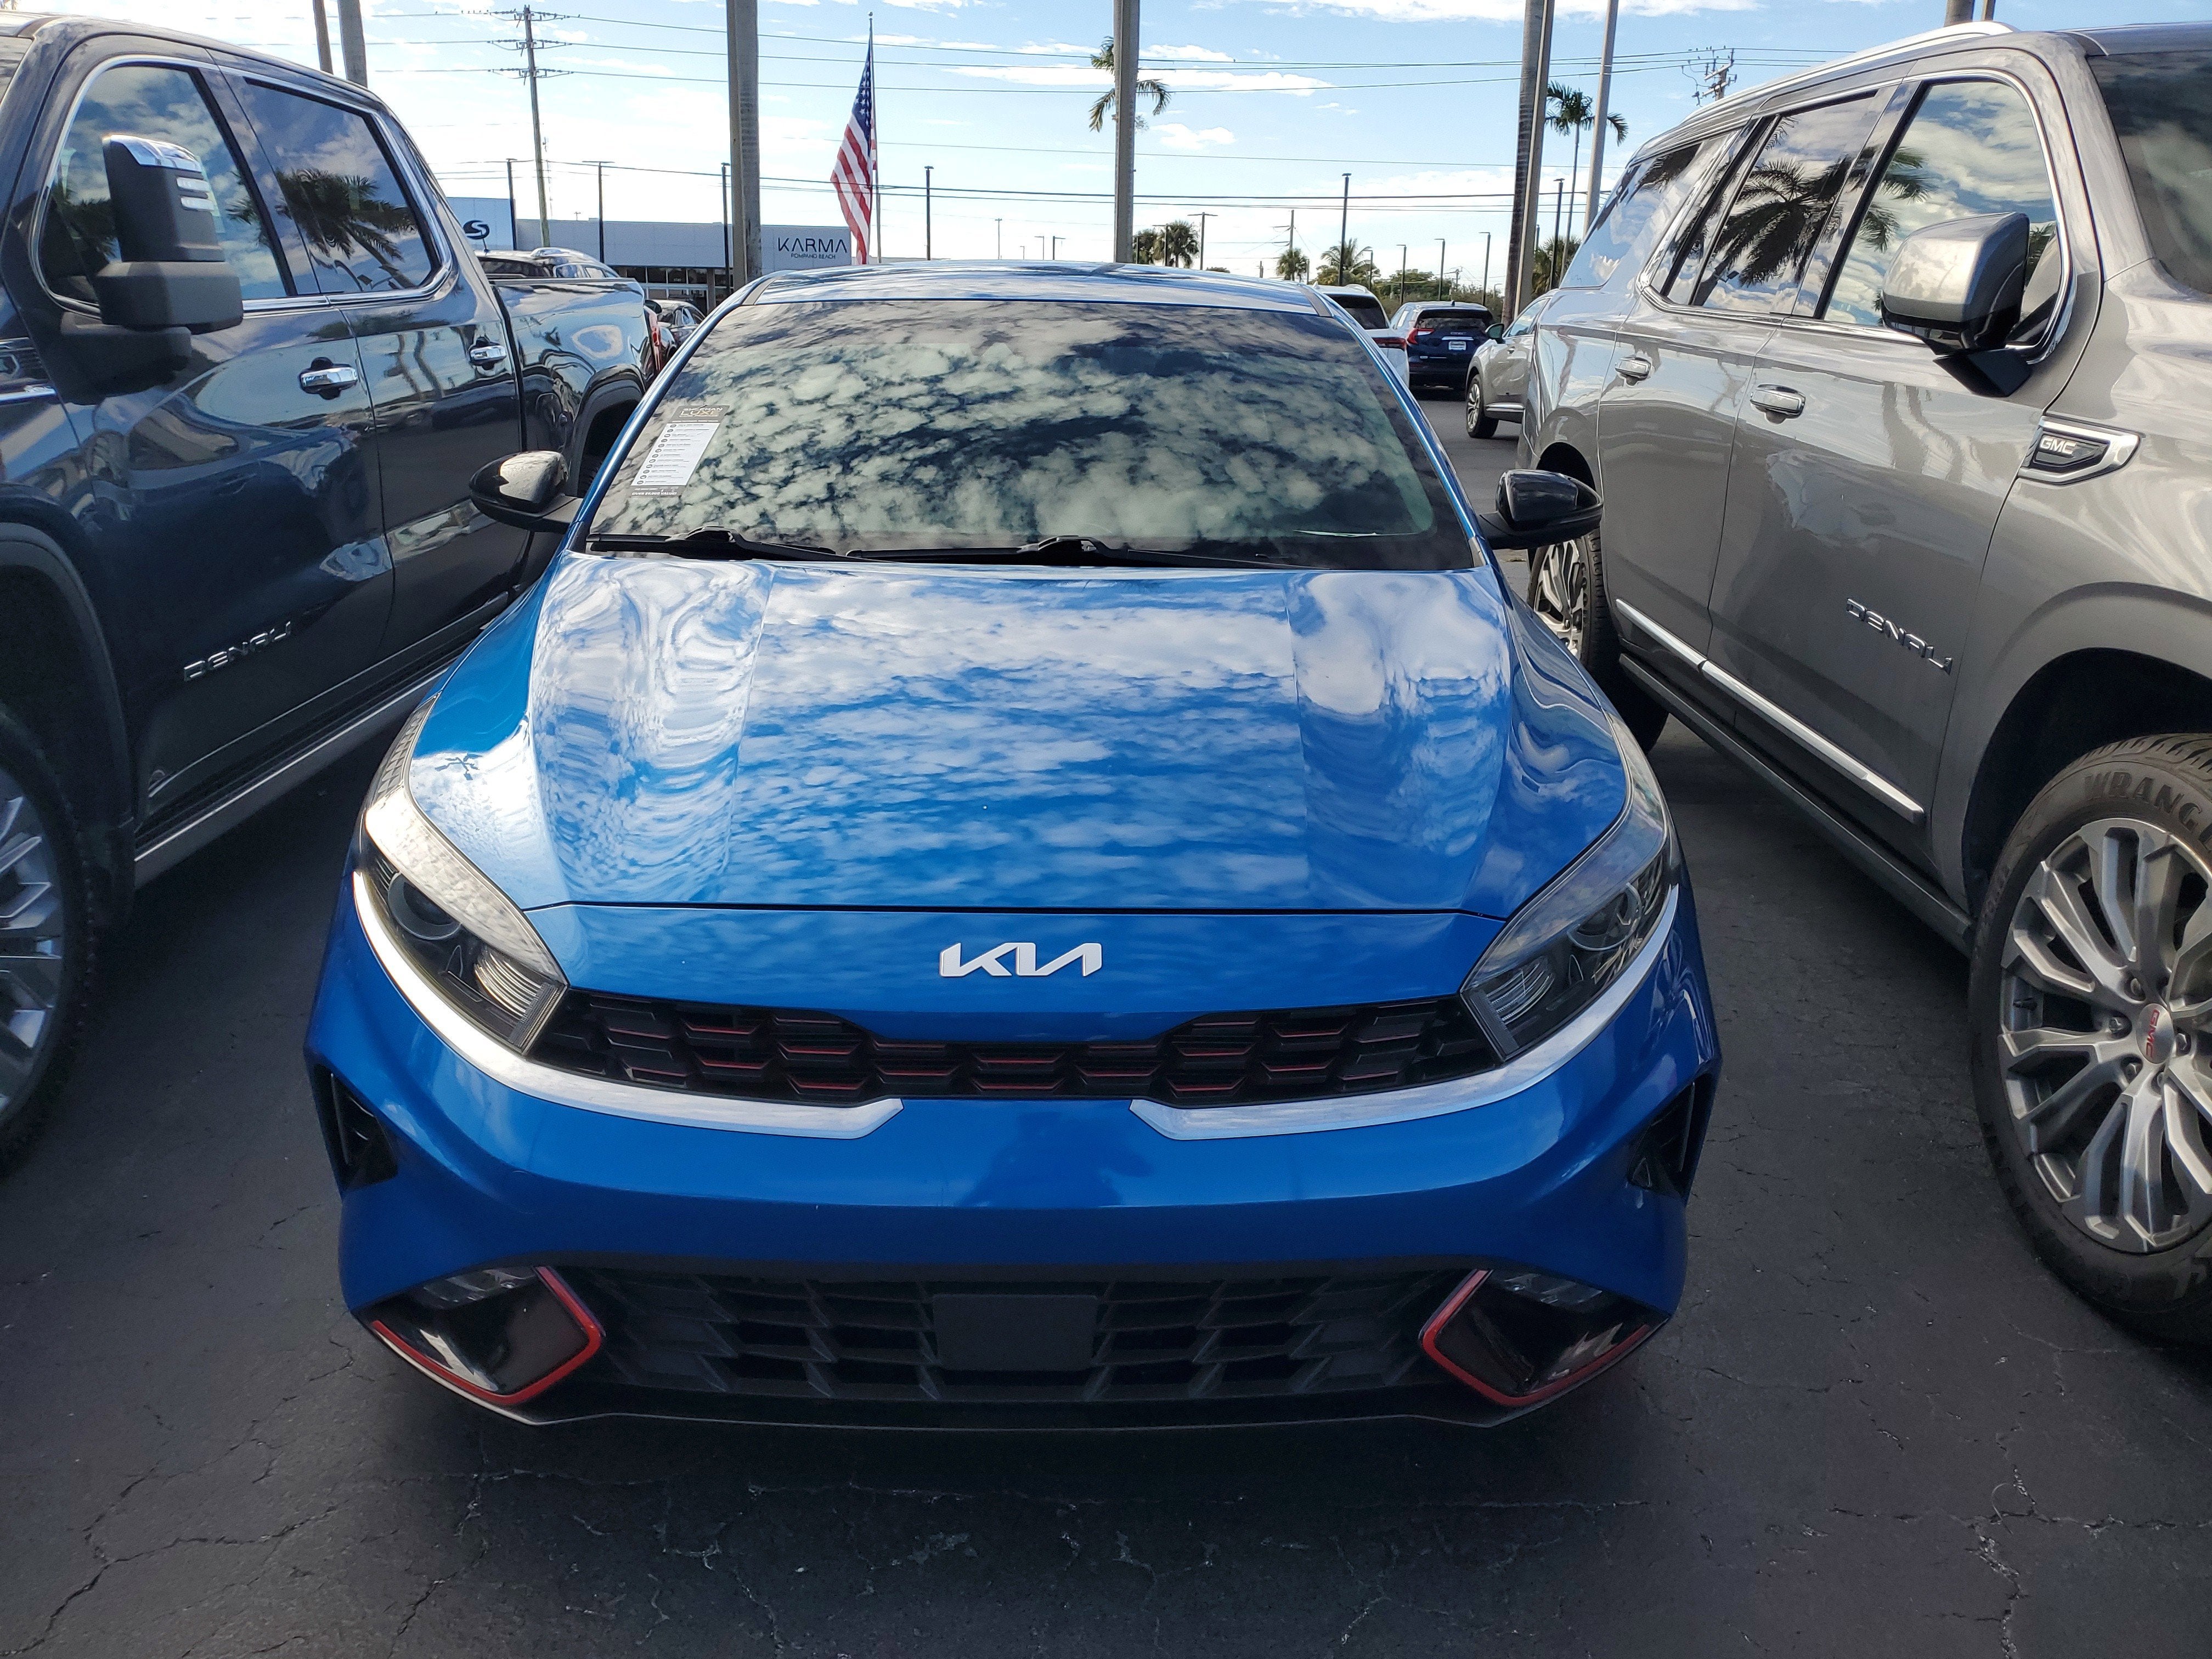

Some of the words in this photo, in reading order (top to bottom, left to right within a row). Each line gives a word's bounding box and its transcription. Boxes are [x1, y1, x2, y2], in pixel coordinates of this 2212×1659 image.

[778, 237, 848, 253] KARMA
[2039, 436, 2076, 455] GMC
[184, 620, 291, 682] DENALI
[1846, 597, 1953, 676] DENALI
[939, 941, 1103, 978] KIA
[2146, 1008, 2160, 1059] GMC
